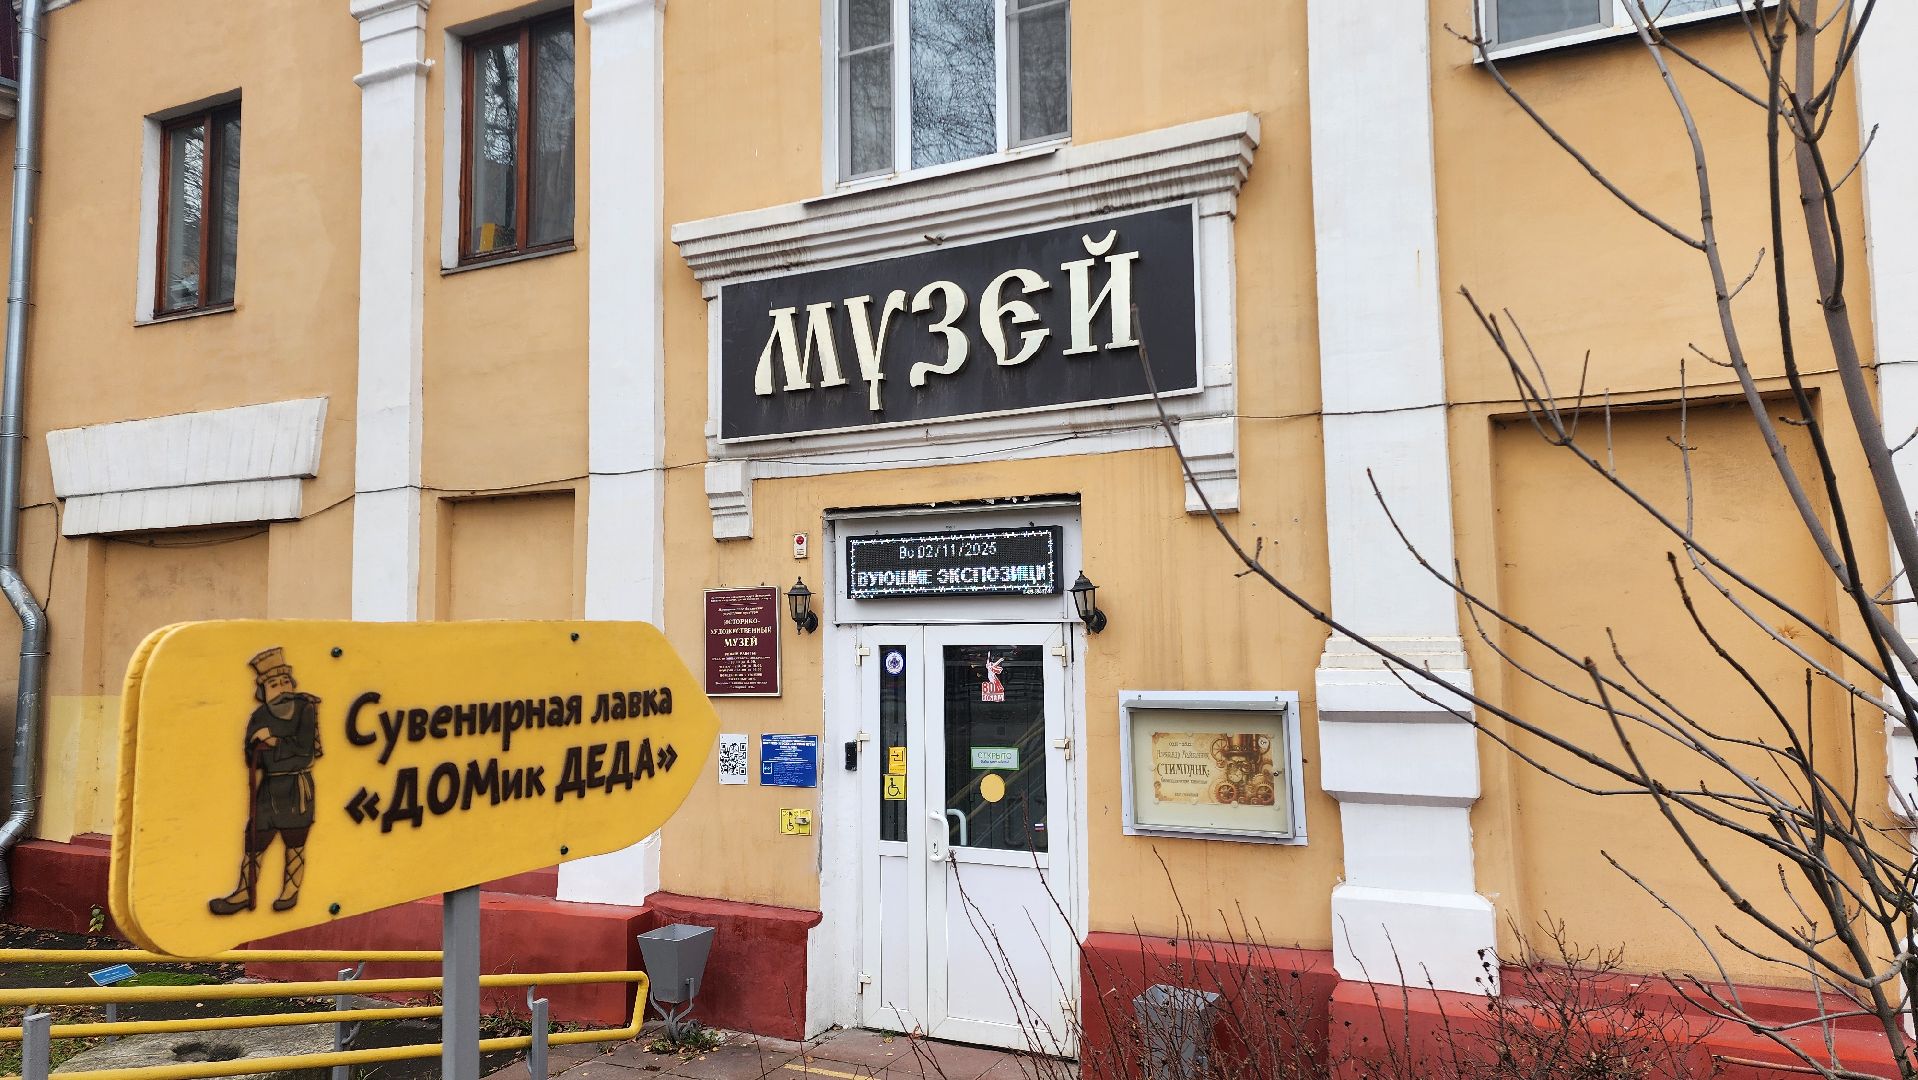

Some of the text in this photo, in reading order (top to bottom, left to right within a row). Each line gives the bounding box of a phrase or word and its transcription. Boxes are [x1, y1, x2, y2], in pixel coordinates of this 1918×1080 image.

[753, 229, 1141, 411] МУЗЕЙ
[917, 541, 997, 559] 02/11/2025
[724, 635, 758, 648] МУЗЕЙ
[345, 686, 673, 765] Сувенирная лавка
[345, 756, 546, 834] «ДОМик
[554, 738, 678, 803] ДЕДА»
